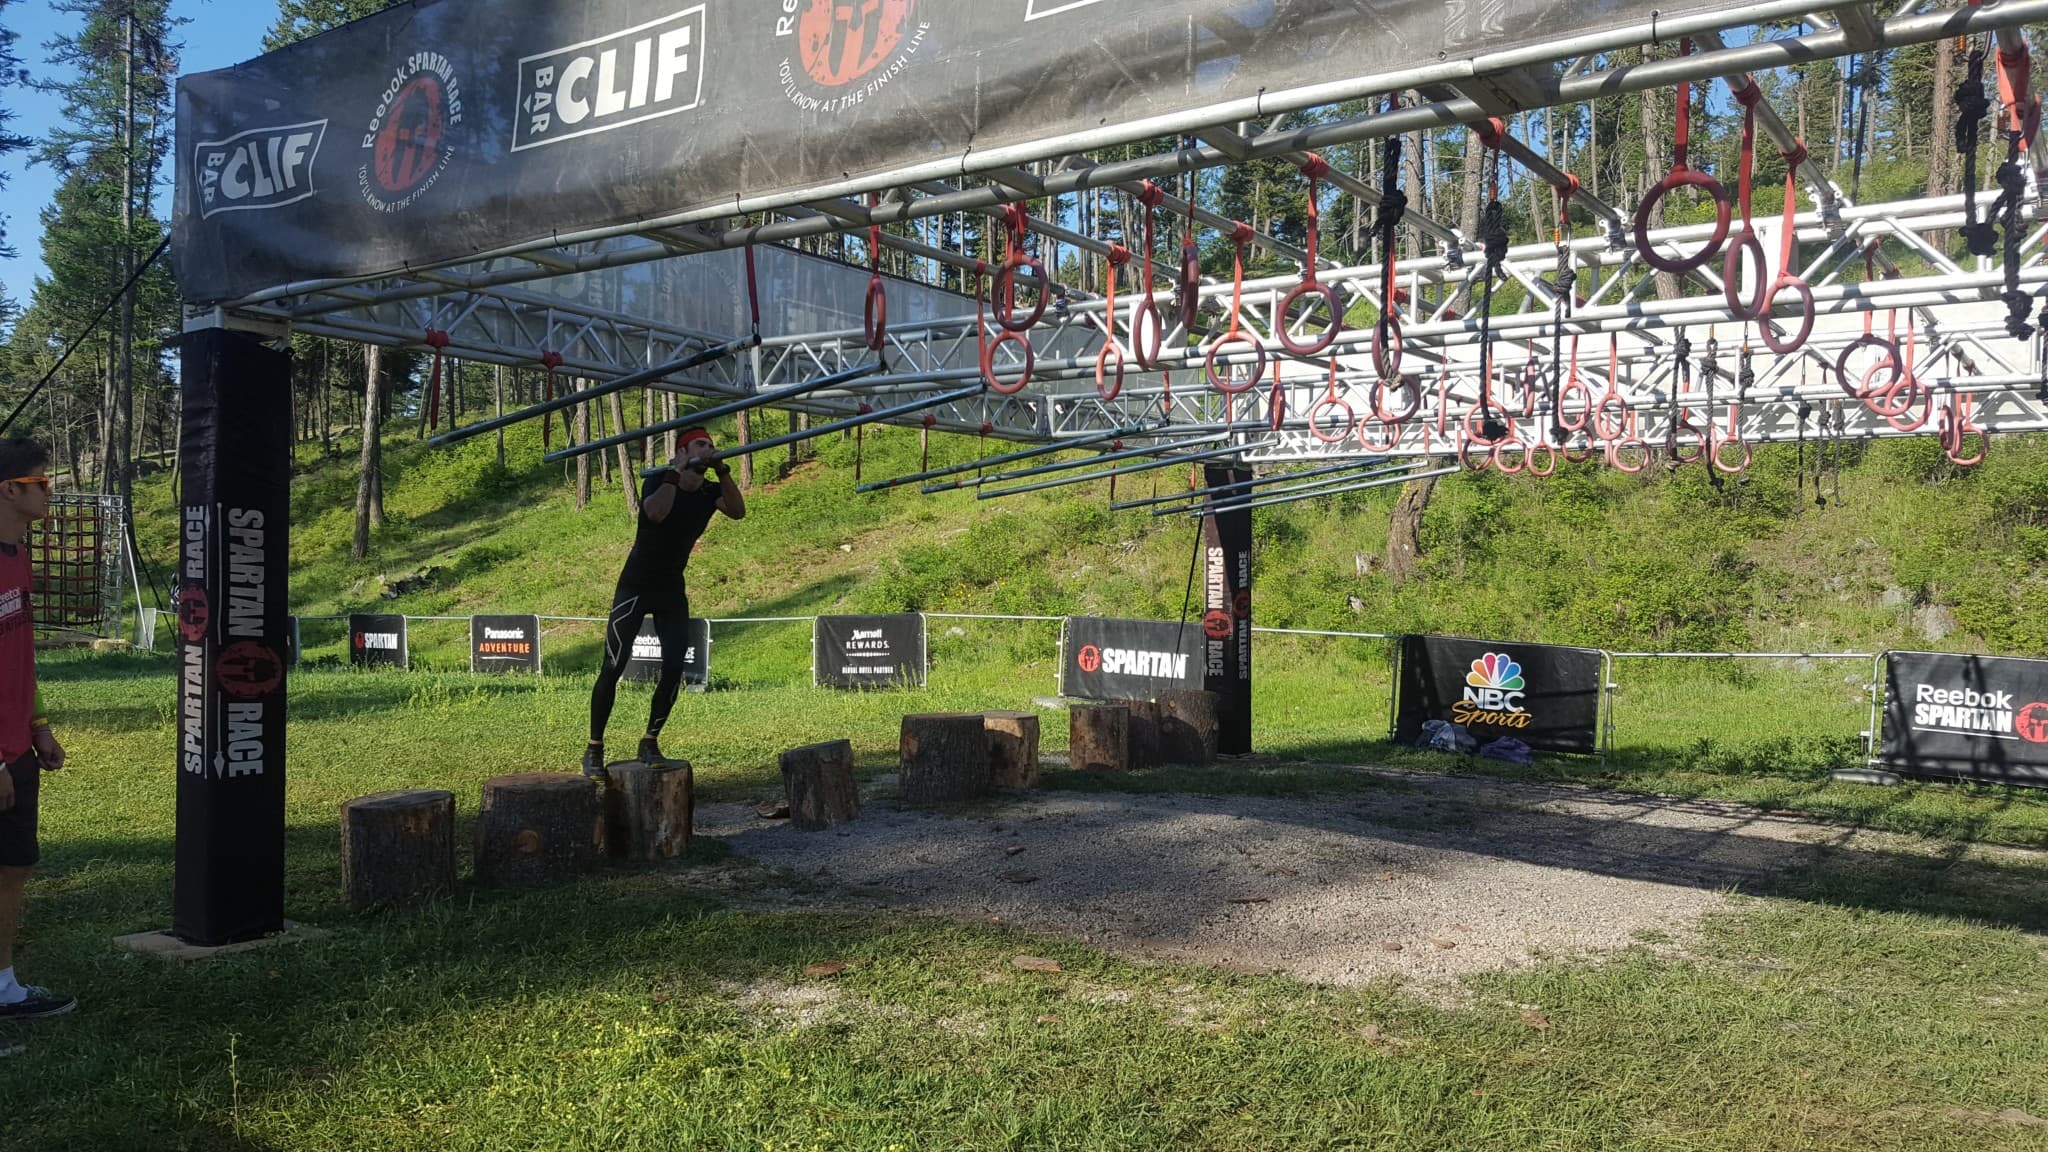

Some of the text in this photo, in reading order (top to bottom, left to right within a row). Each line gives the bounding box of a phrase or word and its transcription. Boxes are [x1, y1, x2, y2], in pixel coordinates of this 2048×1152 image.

[362, 51, 462, 148] Reebok SPARTAN RACE
[530, 65, 554, 135] BAR
[556, 25, 691, 124] CLIF
[779, 21, 930, 113] YOU'LL KNOW AT THE FINISH LINE
[203, 152, 226, 204] BAR
[221, 132, 313, 200] CLIF
[366, 193, 388, 213] KNOW
[386, 202, 396, 214] AT
[397, 195, 411, 211] THE
[412, 170, 440, 201] FINISH
[439, 145, 455, 171] LINE
[184, 505, 204, 774] SPARTAN RACE
[228, 508, 264, 778] SPARTAN RACE
[364, 633, 398, 650] SPARTAN
[484, 626, 525, 640] Panasonic
[1208, 547, 1224, 677] SPARTAN RACE
[1238, 551, 1249, 680] SPARTAN RACE
[479, 642, 531, 654] ADVENTURE
[1101, 647, 1188, 679] SPARTAN
[1451, 700, 1532, 729] Sports
[1463, 686, 1526, 712] NBC
[1914, 703, 2013, 733] SPARTAN
[1916, 683, 2014, 710] Reebok
